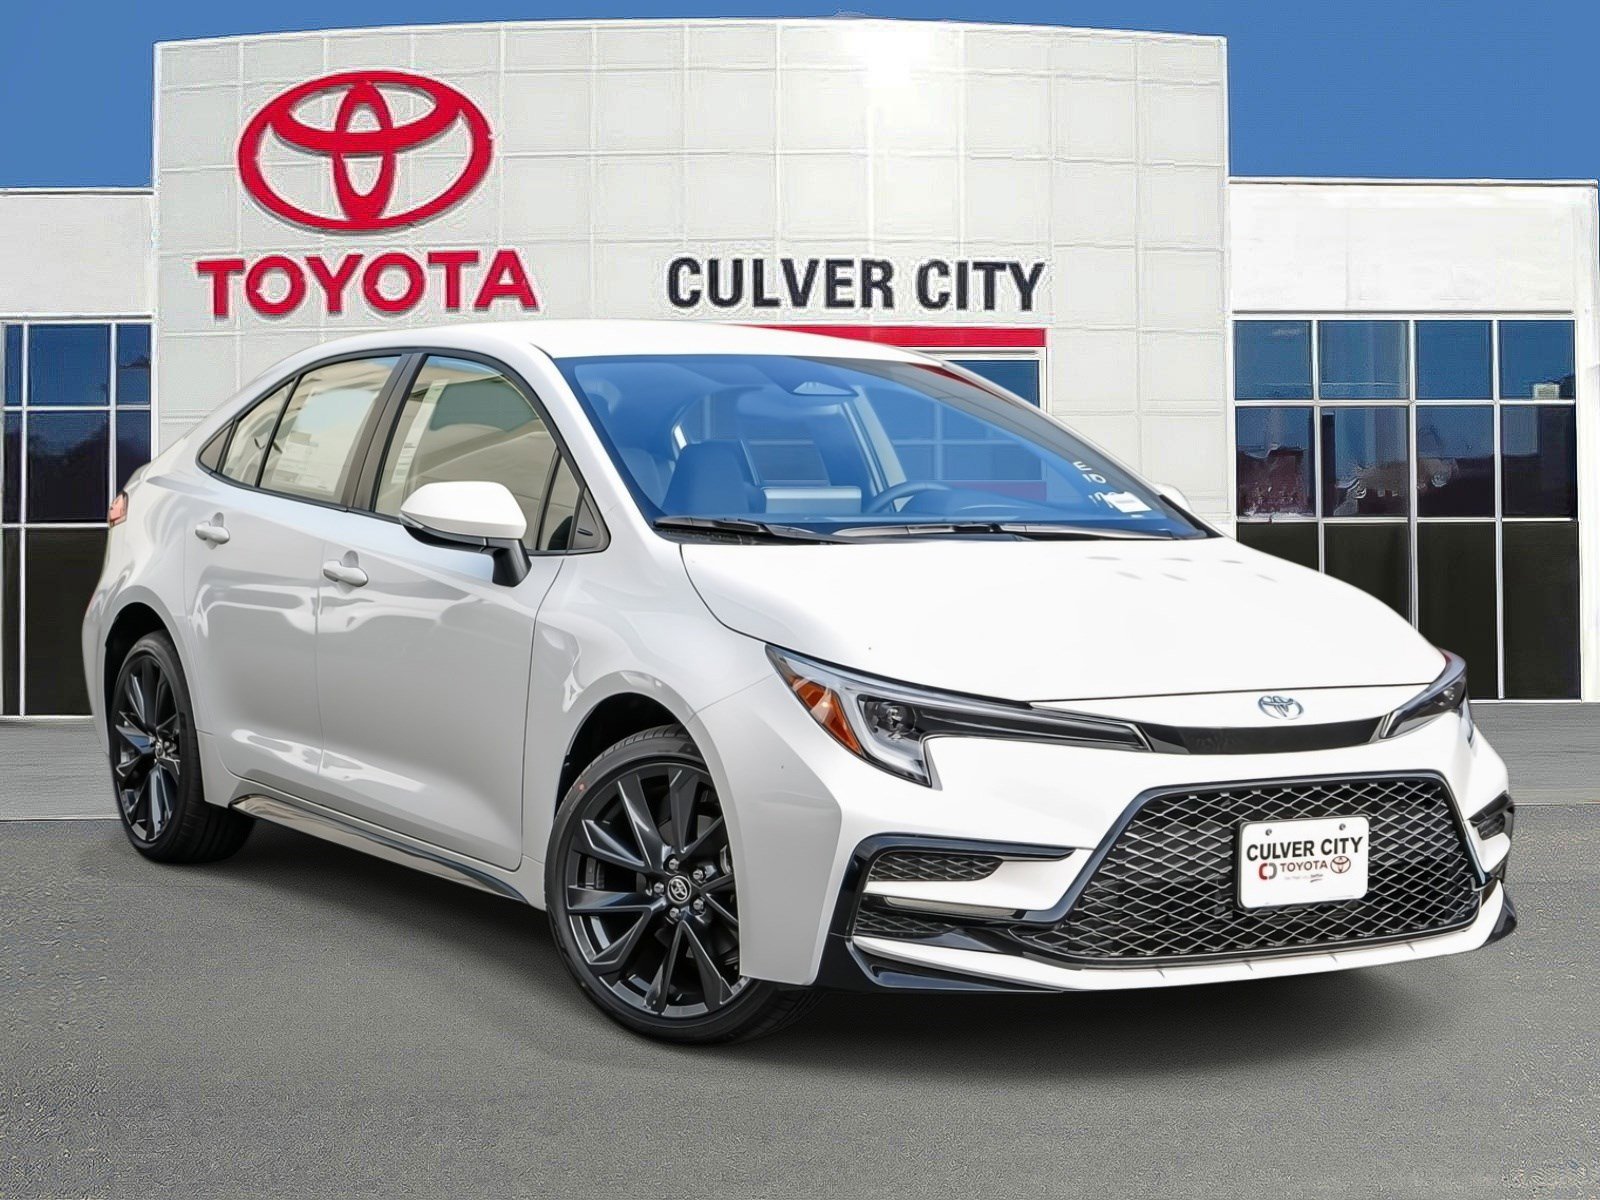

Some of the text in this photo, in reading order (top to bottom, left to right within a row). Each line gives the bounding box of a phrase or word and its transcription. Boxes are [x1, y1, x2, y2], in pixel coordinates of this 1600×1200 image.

[195, 250, 540, 319] TOYOTA
[667, 257, 1046, 311] CULVER CITY
[1246, 836, 1363, 861] CULVER CITY
[1280, 860, 1328, 873] TOYOTA
